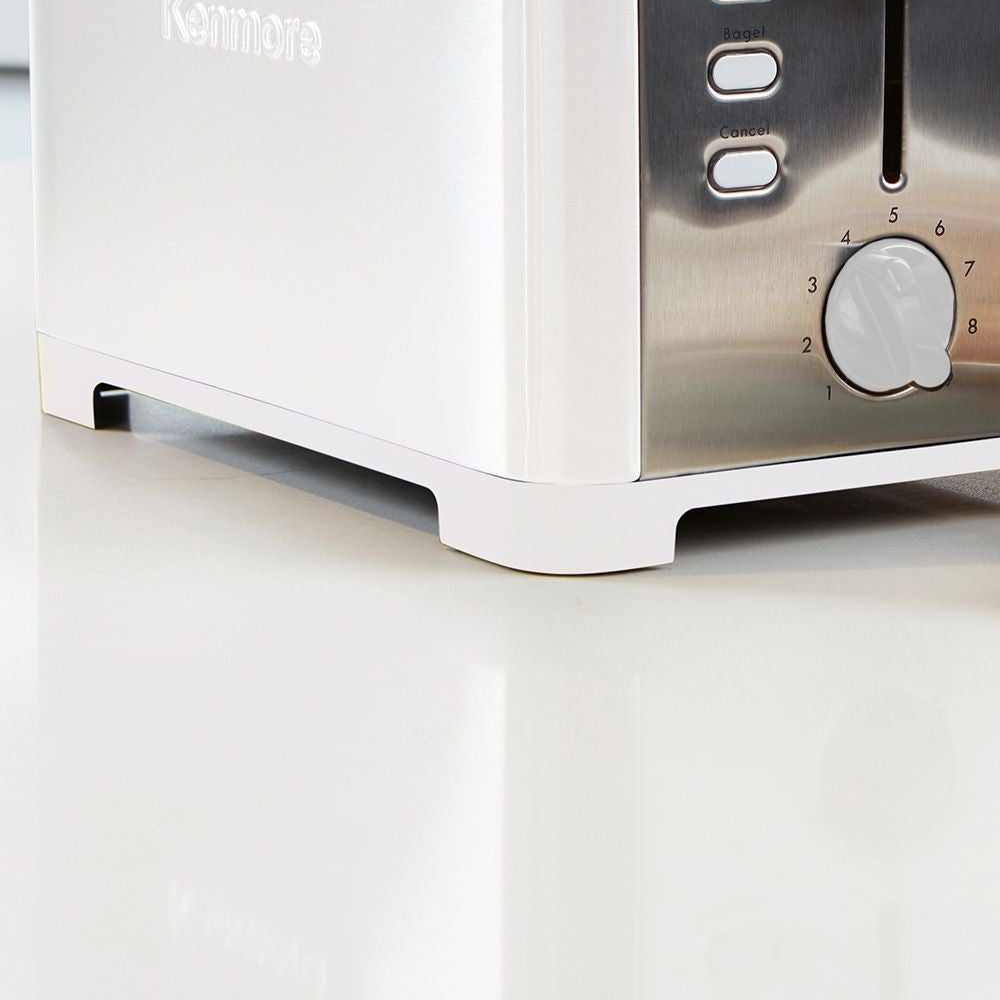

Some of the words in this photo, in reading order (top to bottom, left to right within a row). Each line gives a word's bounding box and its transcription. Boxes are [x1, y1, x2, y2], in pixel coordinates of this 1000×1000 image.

[723, 24, 765, 42] Bagel
[719, 123, 770, 139] Cancel
[888, 207, 898, 223] 5
[935, 220, 945, 236] 6
[841, 230, 851, 245] 4
[964, 260, 975, 277] 7
[807, 276, 817, 293] 3
[968, 318, 978, 334] 8
[802, 336, 812, 353] 2
[826, 385, 831, 400] 1
